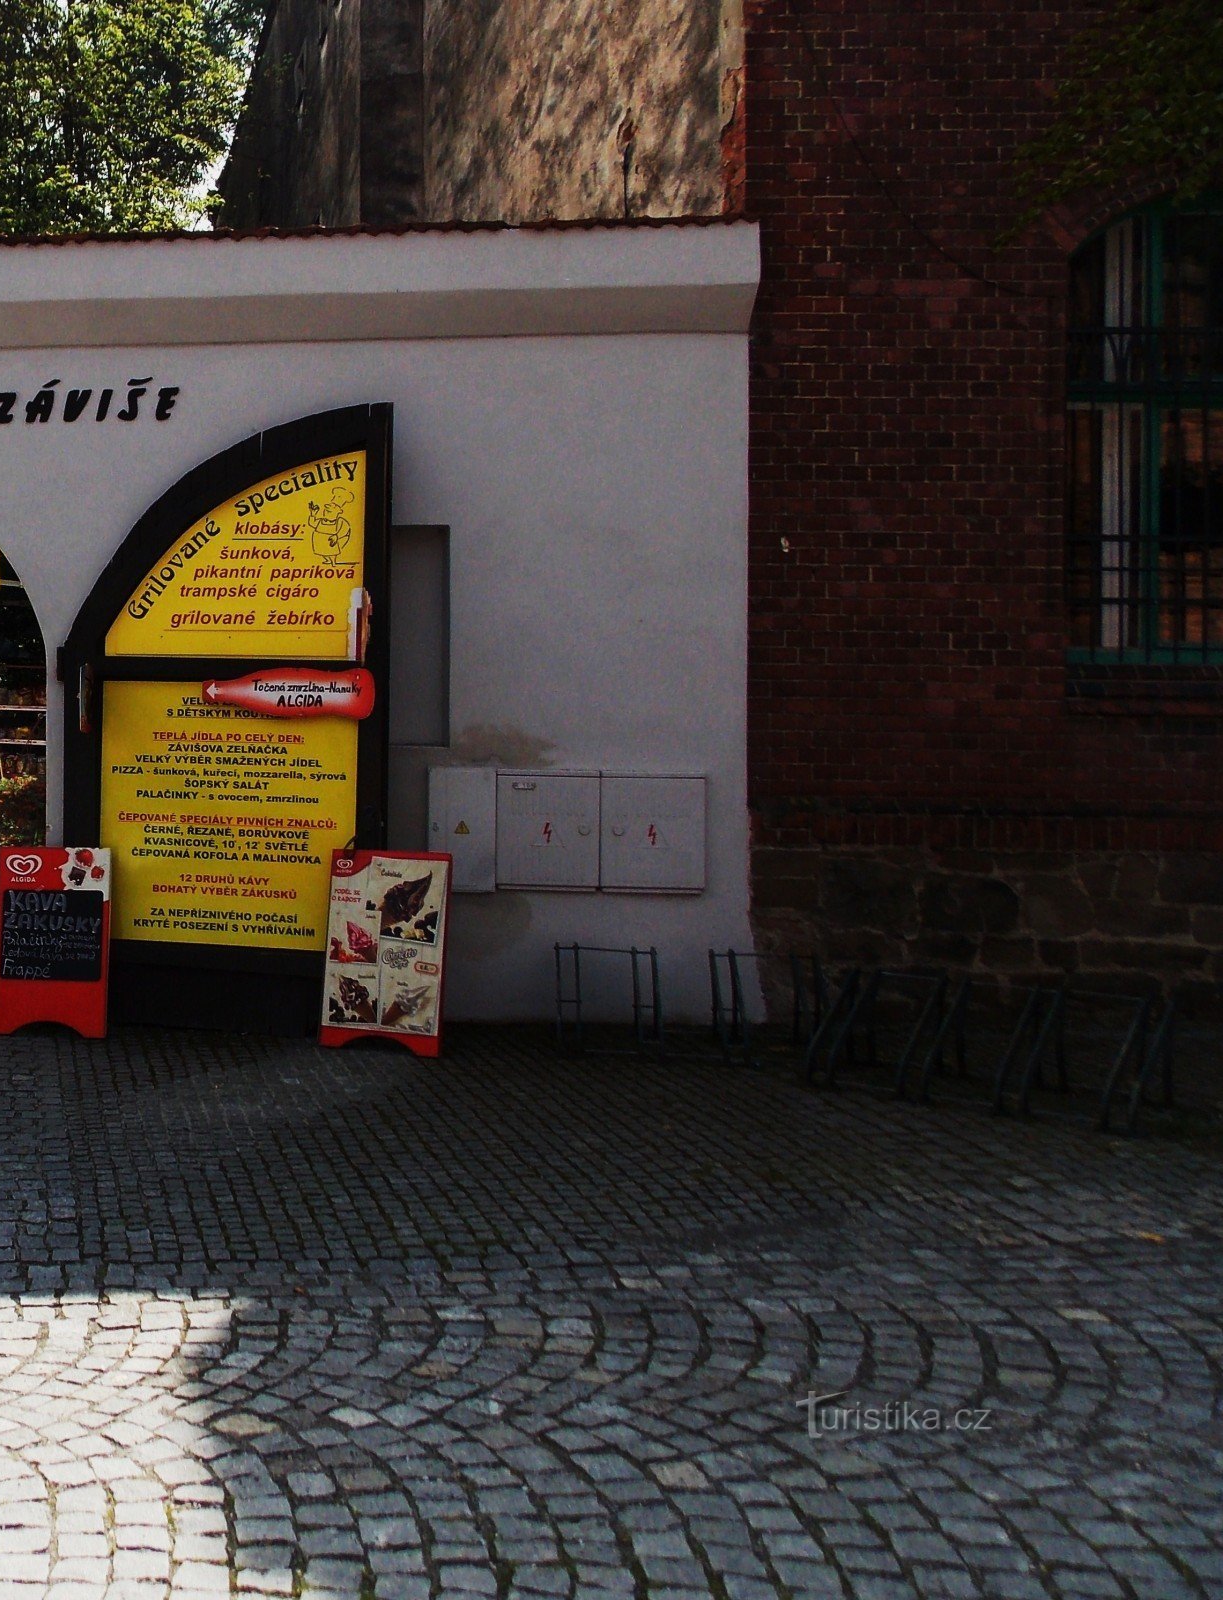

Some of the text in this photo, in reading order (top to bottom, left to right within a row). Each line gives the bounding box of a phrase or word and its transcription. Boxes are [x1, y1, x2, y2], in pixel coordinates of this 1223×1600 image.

[234, 521, 307, 537] klobásy:
[127, 460, 358, 620] Grilované speciality
[219, 546, 295, 562] šunková,
[193, 564, 355, 582] pikantní papriková
[179, 583, 319, 601] trampské cigáro
[170, 610, 335, 629] grilované žebírko
[252, 678, 286, 692] Točená
[276, 694, 323, 707] ALGIDA
[166, 708, 174, 717] S
[177, 707, 231, 718] DĚTSKÝM
[152, 730, 305, 743] TEPLÁ JÍDLA PO CELÝ DEN:
[167, 742, 224, 753] ZÁVIŠOVA
[135, 753, 322, 768] VELKÝ VÝBĚR SMAŽENÝCH JÍDEL
[111, 765, 347, 782] PIZZA šunková, kuřecí, mozzarella, sýrová
[184, 777, 269, 790] ŠOPSKÝ SALÁT
[136, 788, 319, 804] PALAČINKY s ovocem, zmrzlinou
[118, 810, 337, 829] ČEPOVANÉ SPECIÁLY PIVNÍCH ZNALCŮ:
[143, 824, 309, 840] ČERNÉ, ŘEZANÉ, BORŮVKOVÉ
[144, 836, 219, 849] KVASNICOVÉ,
[265, 841, 309, 852] SVĚTLÉ
[131, 847, 322, 865] ČEPOVANÁ KOFOLA A MALINOVKA
[179, 873, 270, 886] 12 DRUHŮ KÁVY
[152, 884, 297, 900] BOHATÝ VÝBĚR ZÁKUSKŮ
[150, 907, 298, 924] ZA NEPŘÍZNIVÉHO POČASÍ
[133, 918, 316, 938] KRYTÉ POSEZENÍ S VYHŘÍVÁNÍM
